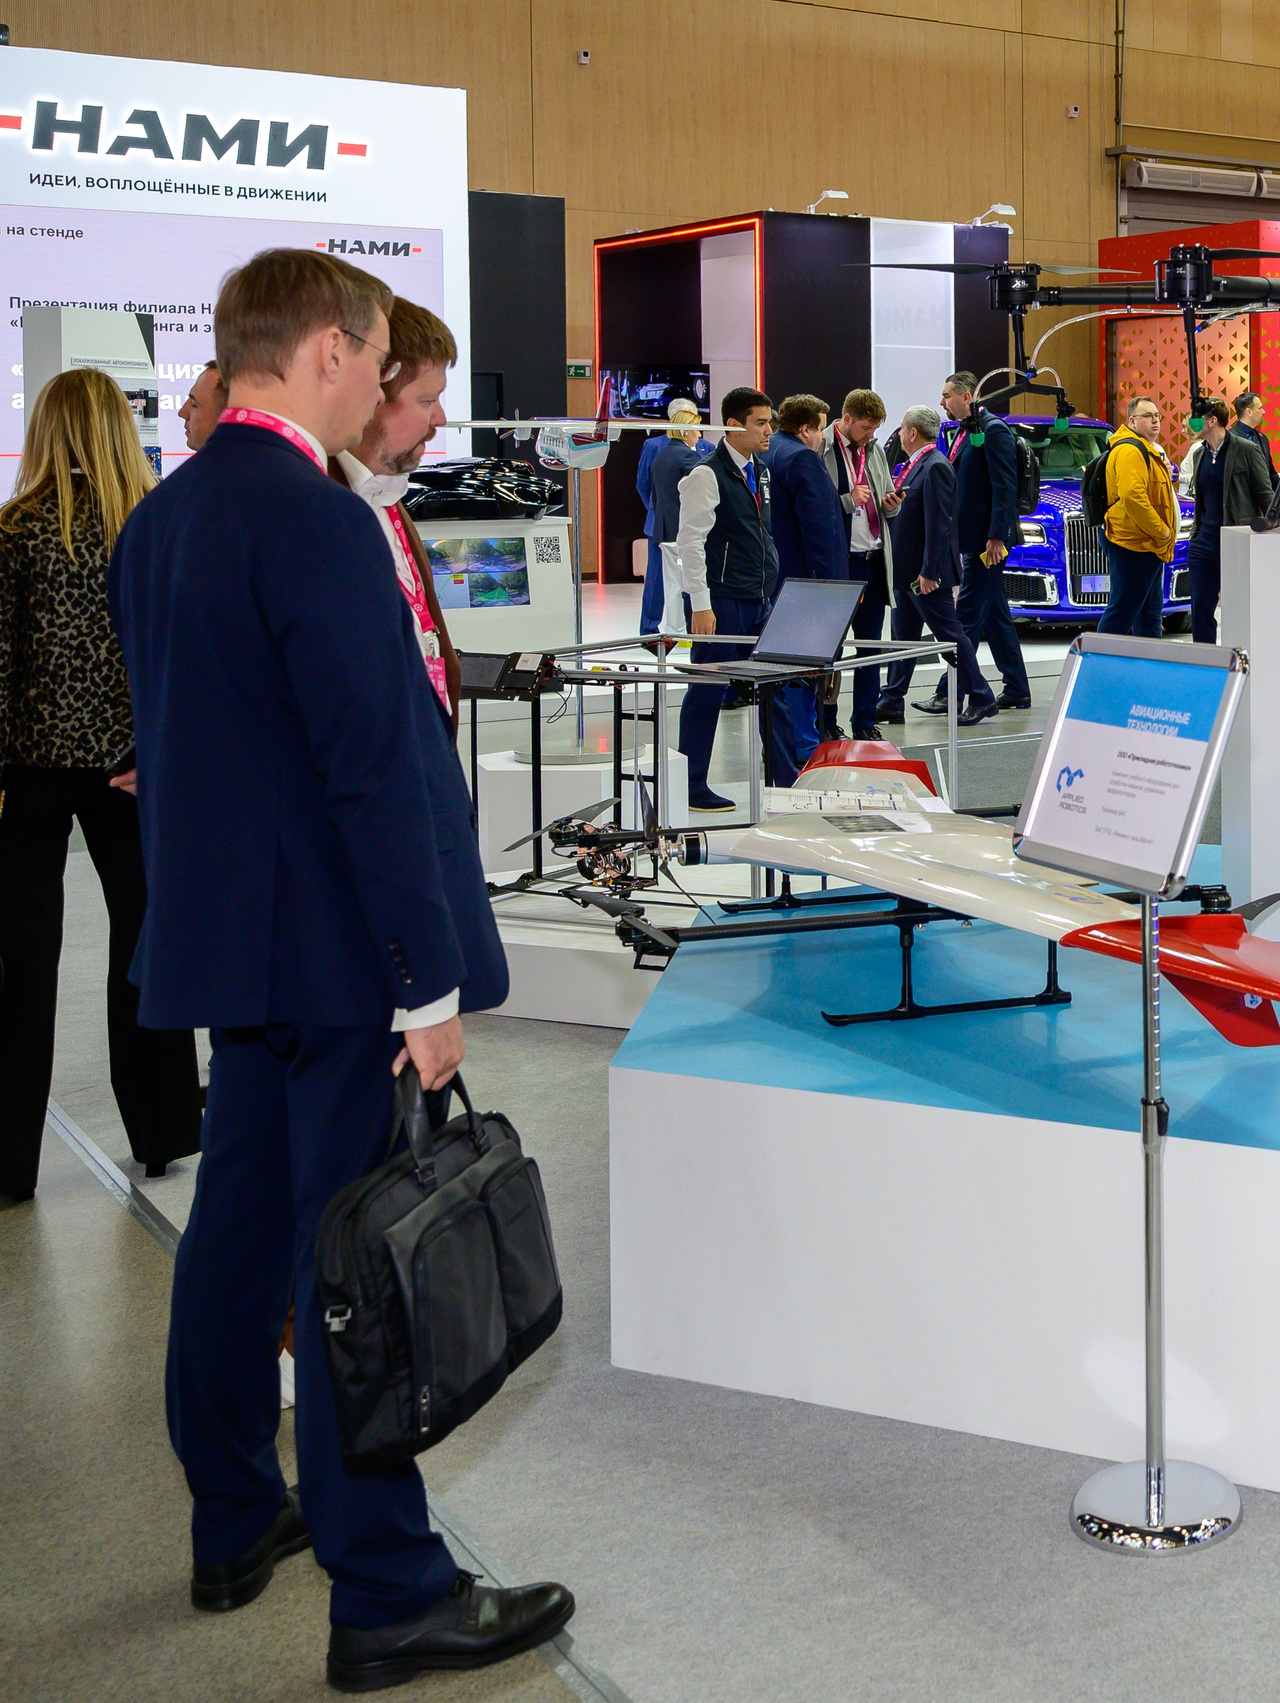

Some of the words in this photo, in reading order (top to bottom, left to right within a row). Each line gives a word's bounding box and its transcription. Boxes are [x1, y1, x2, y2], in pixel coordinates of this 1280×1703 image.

[32, 100, 329, 170] НАМИ
[29, 172, 81, 189] ИДЕИ,
[85, 176, 220, 196] ВОПЛОЩЁННЫЕ
[225, 186, 233, 197] В
[237, 186, 328, 203] ДВИЖЕНИИ
[6, 226, 25, 235] на
[30, 226, 84, 240] стенде
[328, 239, 410, 257] НАМИ
[123, 301, 196, 314] филиала
[189, 323, 198, 332] и
[1129, 704, 1192, 725] АВИАЦИОННЫЕ
[1127, 718, 1179, 737] ТЕХНОЛОГИИ
[1061, 793, 1085, 804] APPLIED
[1059, 801, 1087, 815] ROBOTICS
